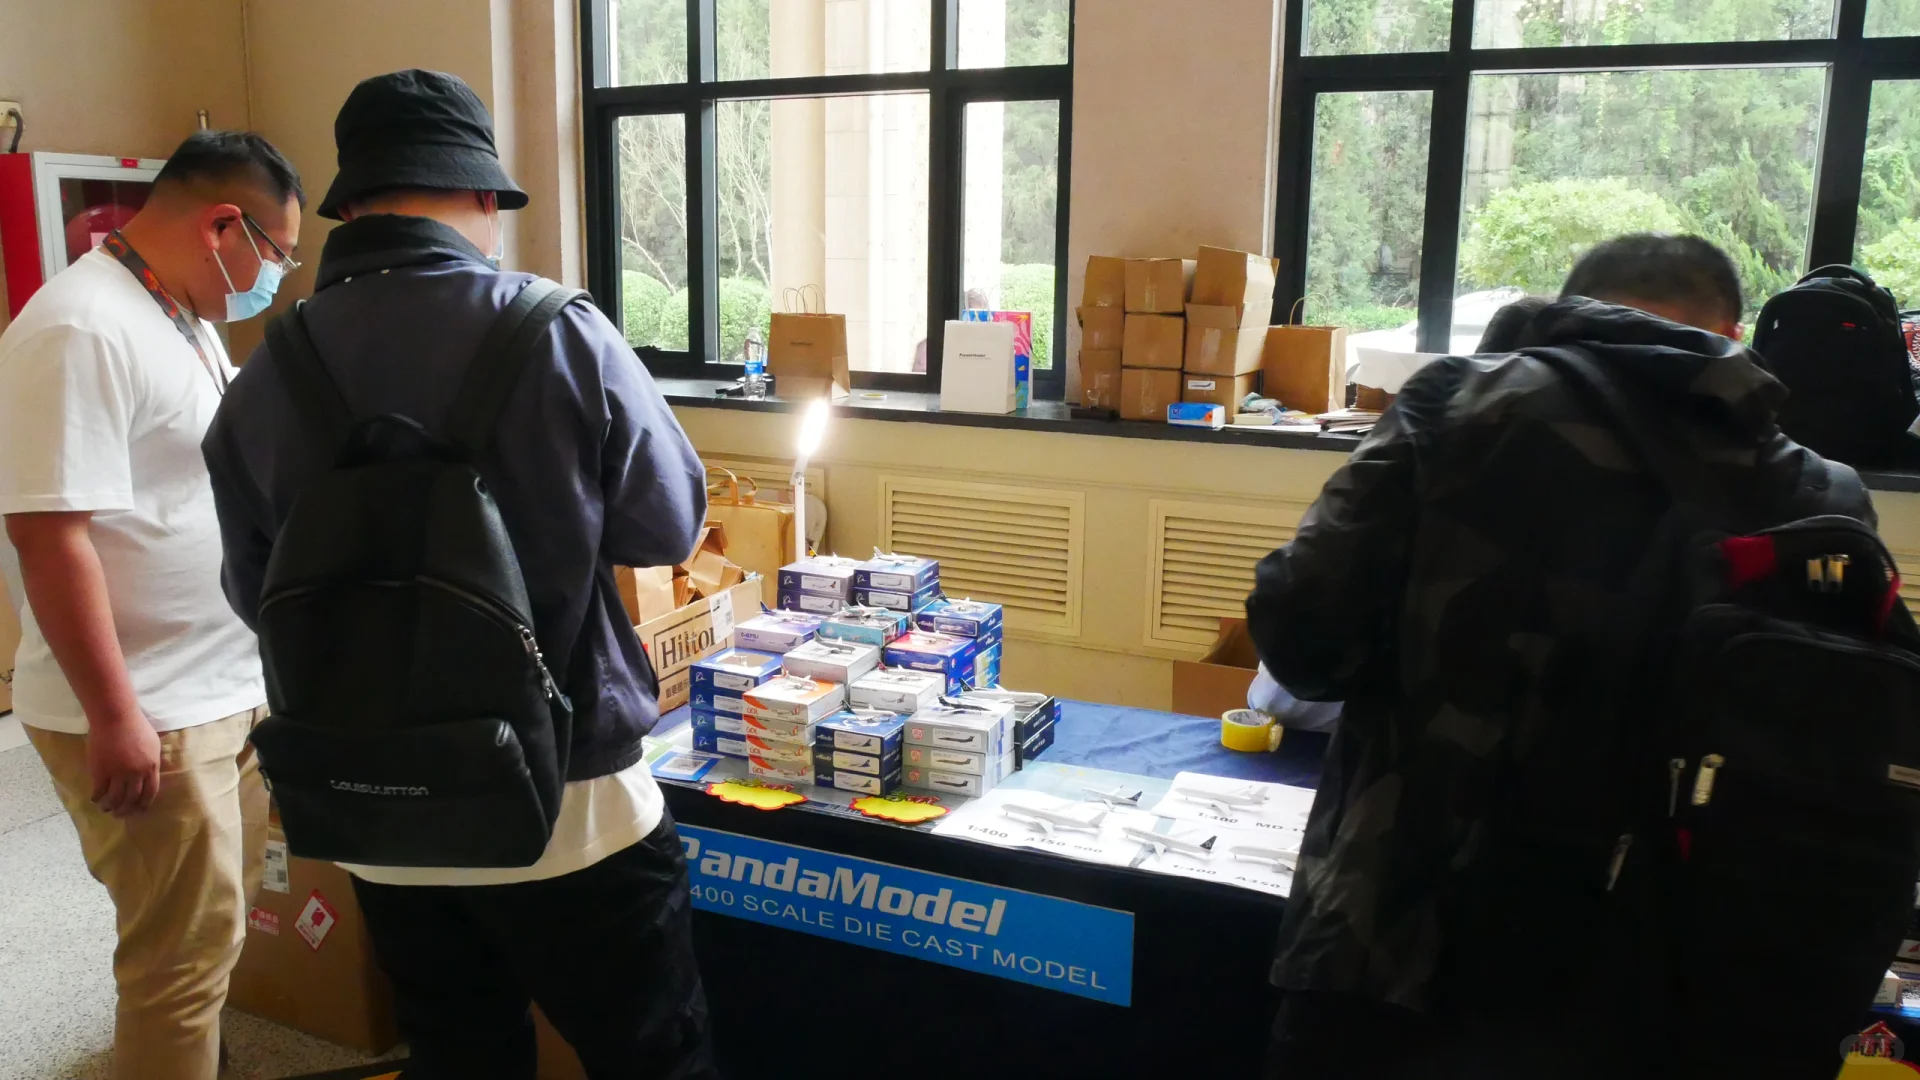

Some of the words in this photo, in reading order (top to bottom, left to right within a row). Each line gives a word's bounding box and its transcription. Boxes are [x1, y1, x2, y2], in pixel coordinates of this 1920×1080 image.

[1198, 811, 1239, 824] 1:400
[967, 823, 1009, 839] 1:400
[1173, 864, 1217, 875] 1:400
[744, 896, 835, 928] SCALE
[844, 916, 892, 941] DIE
[902, 929, 984, 961] CAST
[993, 949, 1107, 990] MODEL
